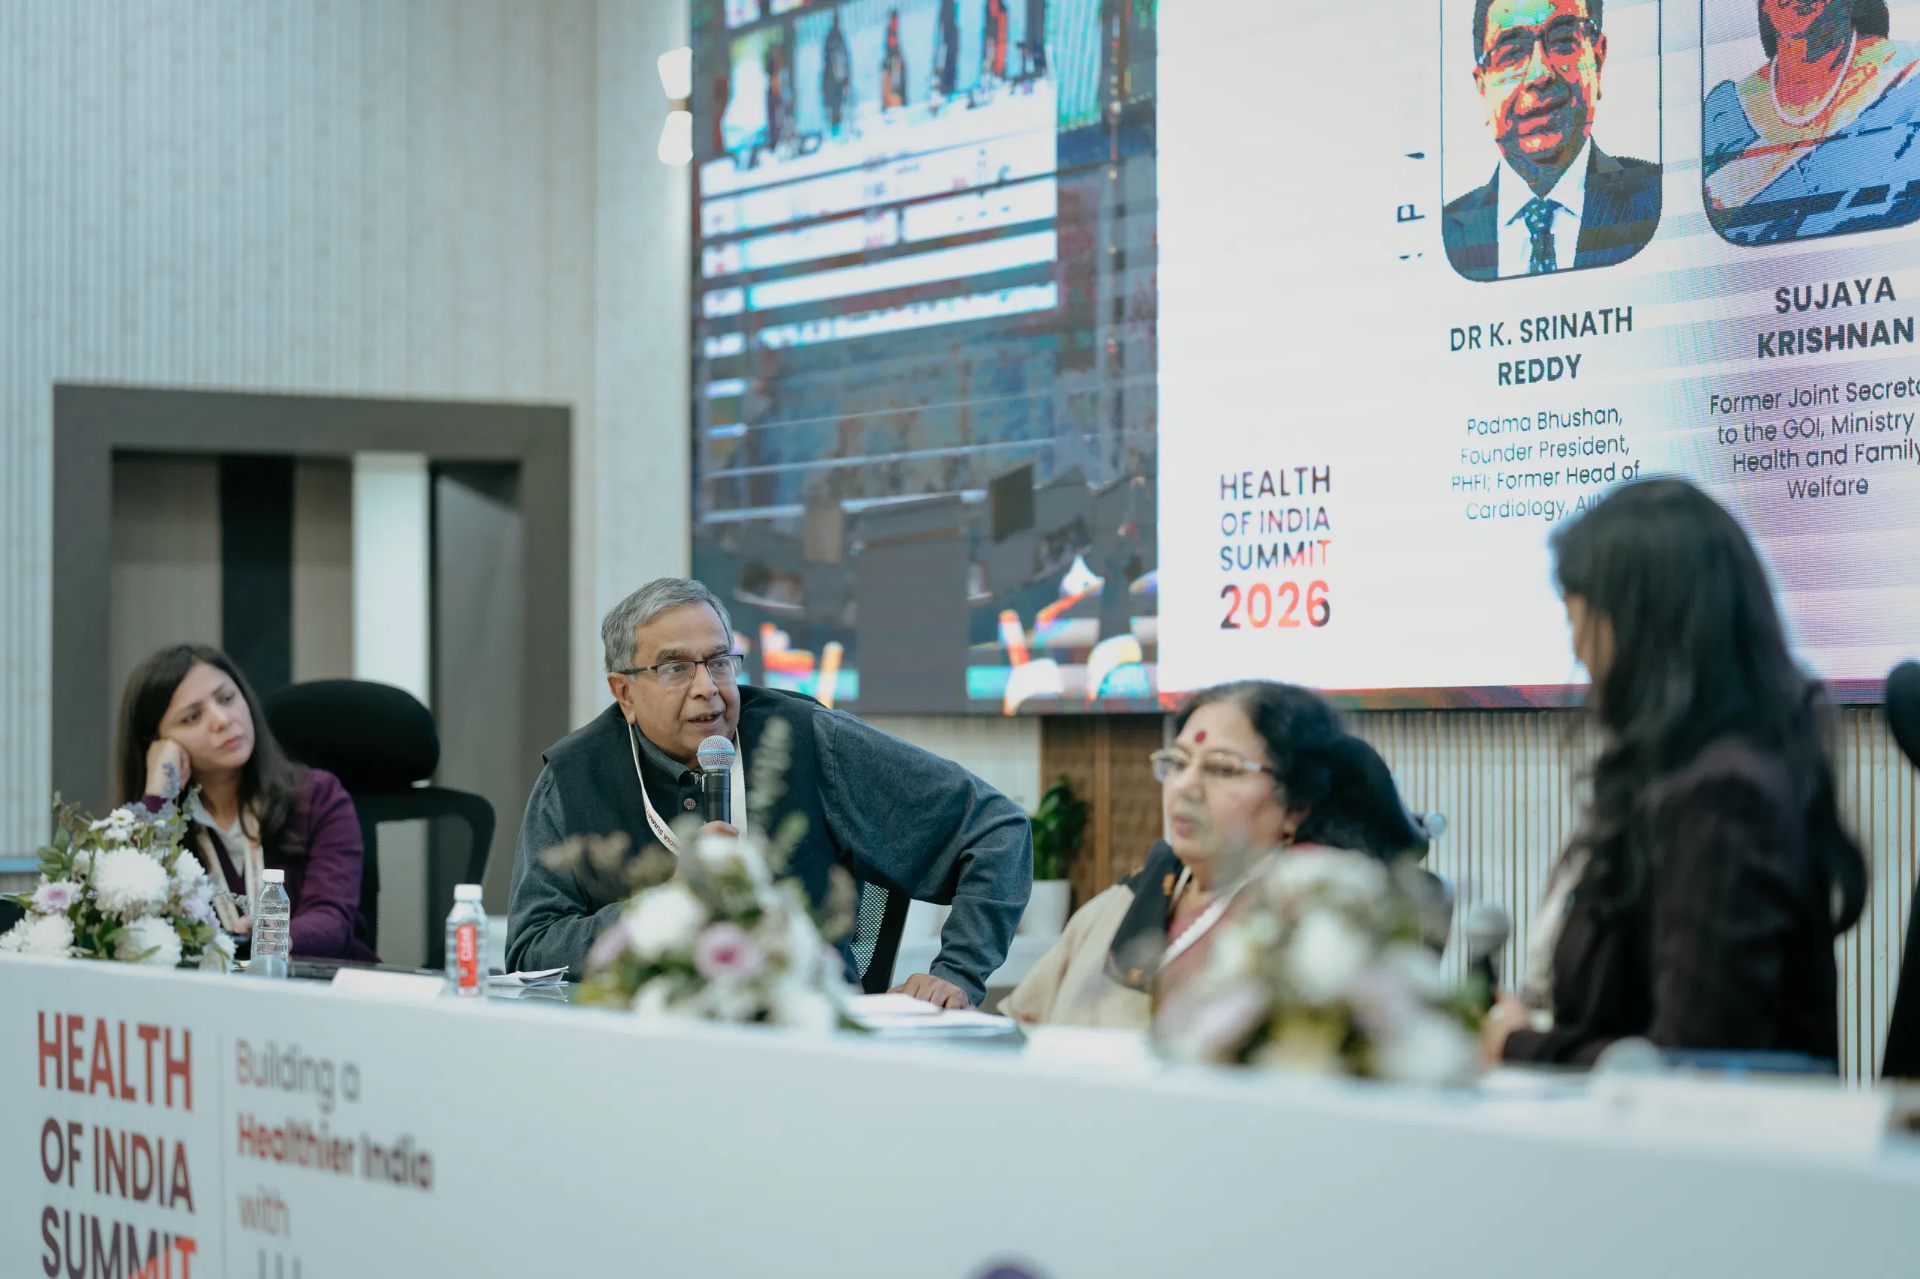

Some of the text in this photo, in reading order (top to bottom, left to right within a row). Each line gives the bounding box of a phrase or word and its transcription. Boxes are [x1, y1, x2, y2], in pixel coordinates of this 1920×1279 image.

[1774, 276, 1897, 314] SUJAYA
[1450, 305, 1633, 352] DR K. SRINATH
[1757, 316, 1914, 359] KRISHNAN
[1498, 353, 1582, 386] REDDY
[1710, 391, 1782, 415] Former
[1788, 384, 1839, 408] Joint
[1467, 406, 1623, 436] Padma Bhushan,
[1718, 411, 1915, 445] to the GOI, Ministry
[1461, 434, 1630, 465] Founder President,
[1733, 448, 1800, 473] Health
[1806, 443, 1848, 468] and
[1220, 465, 1330, 501] HEALTH
[1452, 460, 1641, 493] PHFI; Former Head of
[1787, 475, 1869, 499] Welfare
[1221, 506, 1331, 537] OF INDIA
[1466, 498, 1569, 521] Cardiology,
[1220, 539, 1332, 572] SUMMIT
[1220, 579, 1331, 629] 2026
[37, 1010, 193, 1112] HEALTH
[236, 1038, 360, 1114] Building a
[40, 1116, 196, 1213] OF INDIA
[237, 1113, 434, 1192] Healthier India
[238, 1183, 290, 1238] with
[41, 1205, 197, 1279] SUMMIT
